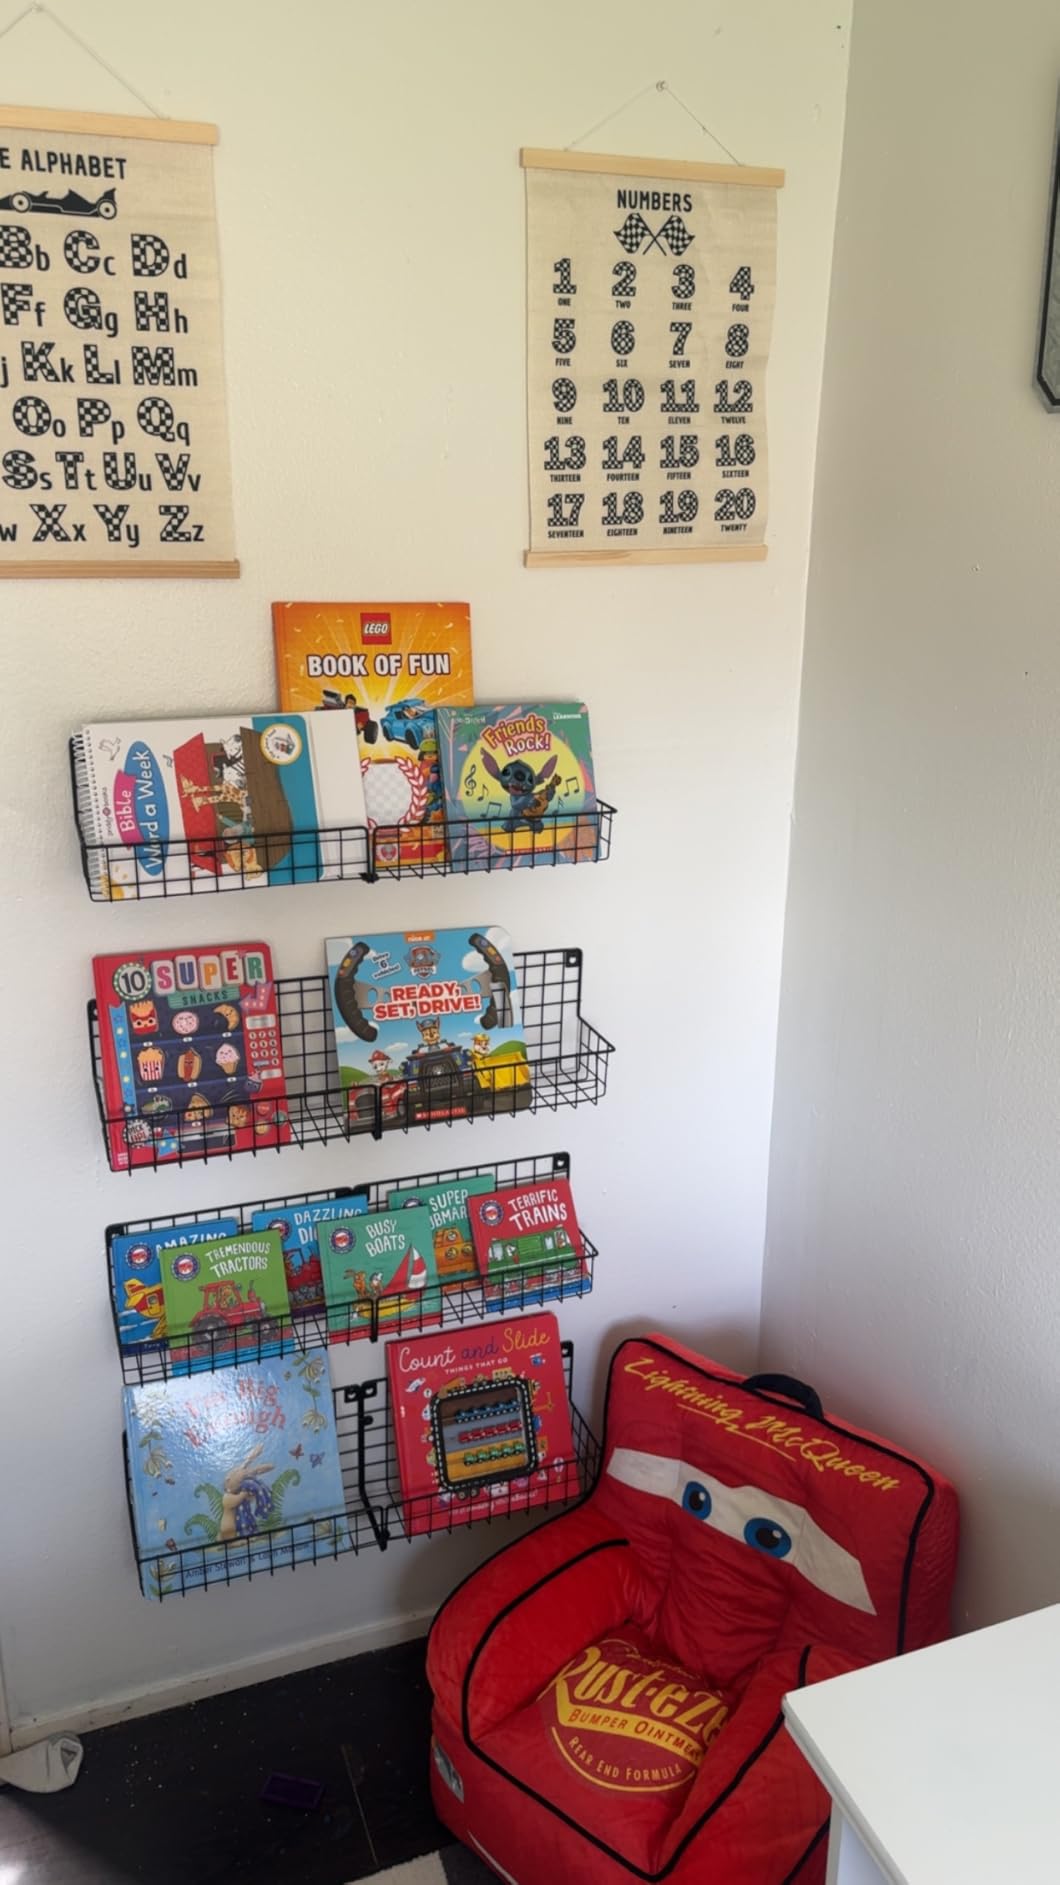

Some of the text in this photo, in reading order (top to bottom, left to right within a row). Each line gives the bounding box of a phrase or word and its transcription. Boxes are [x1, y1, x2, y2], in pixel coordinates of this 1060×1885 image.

[21, 149, 127, 179] ALPHABET
[617, 189, 693, 213] NUMBERS
[553, 258, 755, 301] 1 2 3 4
[558, 298, 749, 312] ONE TWO THREE FOUR
[552, 318, 750, 358] 5 6 7 8
[555, 358, 744, 369] FIVE SIX SEVEN EIGHT
[552, 377, 753, 413] 9 10 11 12
[557, 416, 746, 425] NINE TEN ELEVEN TWELVE
[544, 433, 756, 471] 13 14 15 16
[550, 469, 750, 483] THIRTEEN FOURTEEN FIFTEEN SIXTEEN
[547, 487, 756, 527] 17 18 19 20
[547, 524, 747, 539] SEVENTEEN EIGHTEEN NINETEEN TWENTY
[363, 622, 388, 635] LEGO
[306, 653, 451, 677] BOOK OF FUN
[482, 714, 545, 750] Friends
[132, 750, 154, 800] Week
[116, 790, 135, 832] Bible
[145, 804, 157, 816] a
[157, 957, 263, 989] SUPER
[380, 959, 388, 969] 6
[121, 971, 145, 993] 10
[392, 982, 461, 1001] READY,
[182, 990, 229, 1006] SNACKS
[374, 996, 481, 1020] SET, DRIVE!
[508, 1189, 558, 1212] TERRIFIC
[365, 1219, 397, 1239] BUSY
[509, 1203, 567, 1232] TRAINS
[205, 1242, 271, 1263] TREMENDOUS
[365, 1235, 405, 1257] BOATS
[210, 1256, 268, 1278] TRACTORS
[399, 1328, 550, 1373] Count and Slide
[445, 1364, 473, 1375] THINGS
[476, 1359, 495, 1368] THAT
[624, 1358, 899, 1490] Lightning McQueen
[568, 1709, 700, 1760] BUMPER OINTMEN
[569, 1736, 681, 1780] REAR END FORMULA
